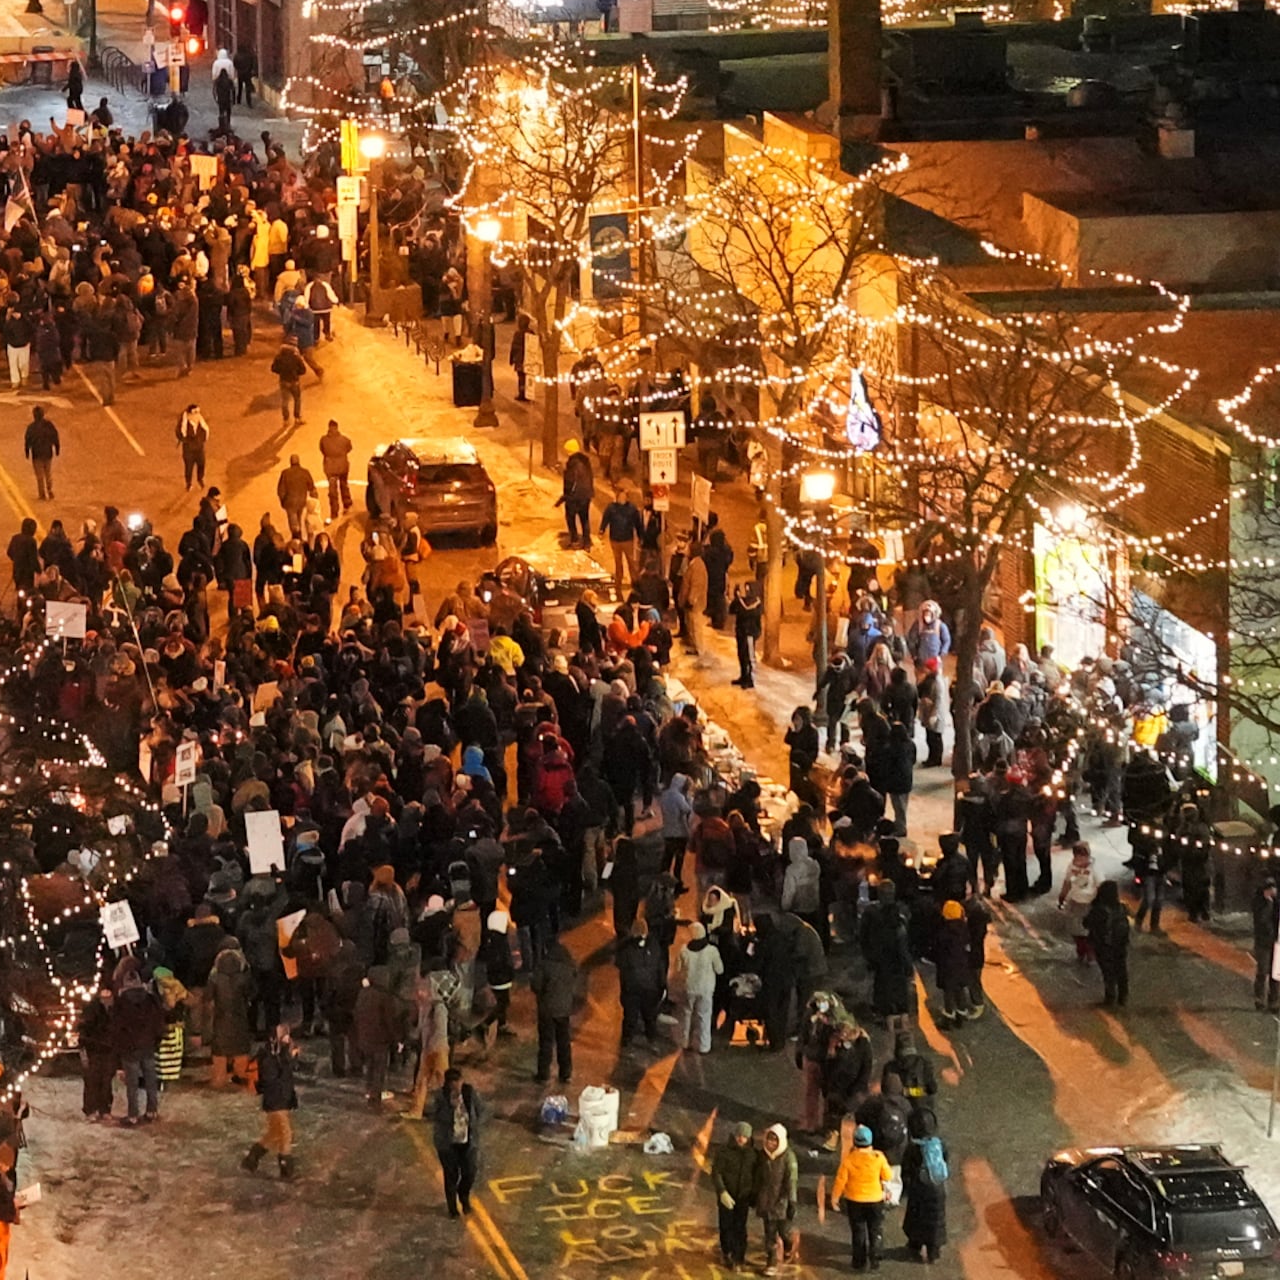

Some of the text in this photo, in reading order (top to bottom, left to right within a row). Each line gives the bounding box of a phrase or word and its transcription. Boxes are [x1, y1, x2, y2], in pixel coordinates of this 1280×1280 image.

[487, 1170, 684, 1205] FUCK
[536, 1195, 674, 1223] ICE
[560, 1219, 698, 1246] LOVE
